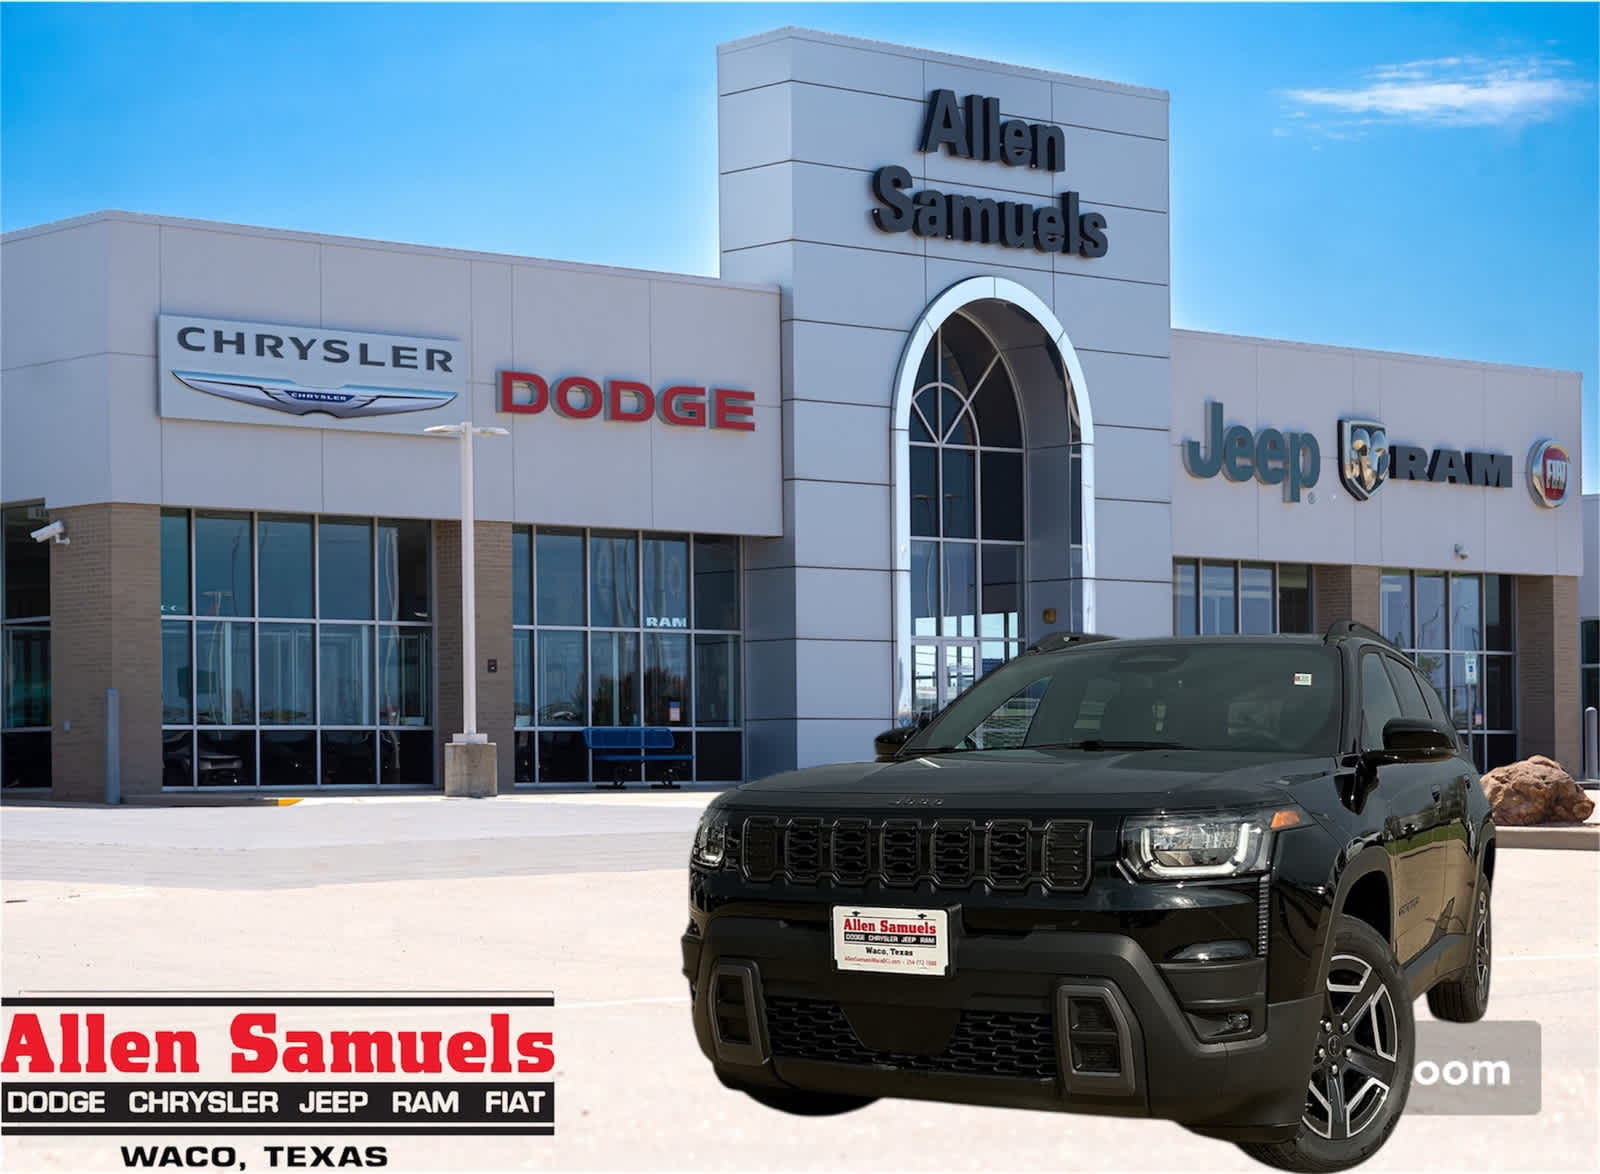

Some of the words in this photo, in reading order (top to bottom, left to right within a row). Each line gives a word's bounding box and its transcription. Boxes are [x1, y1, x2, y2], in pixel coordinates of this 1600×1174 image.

[919, 88, 1066, 172] Allen
[872, 165, 1108, 258] Samuels
[177, 326, 453, 373] CHRYSLER
[496, 370, 755, 432] DODGE
[1182, 400, 1321, 503] Jeep
[1388, 445, 1513, 488] RAM
[1545, 459, 1568, 490] FIAT
[646, 616, 687, 628] RAM
[843, 918, 876, 932] Allen
[880, 920, 937, 935] Samuels
[900, 936, 917, 944] JEEP
[865, 946, 889, 956] Waco,
[890, 948, 914, 956] Texas
